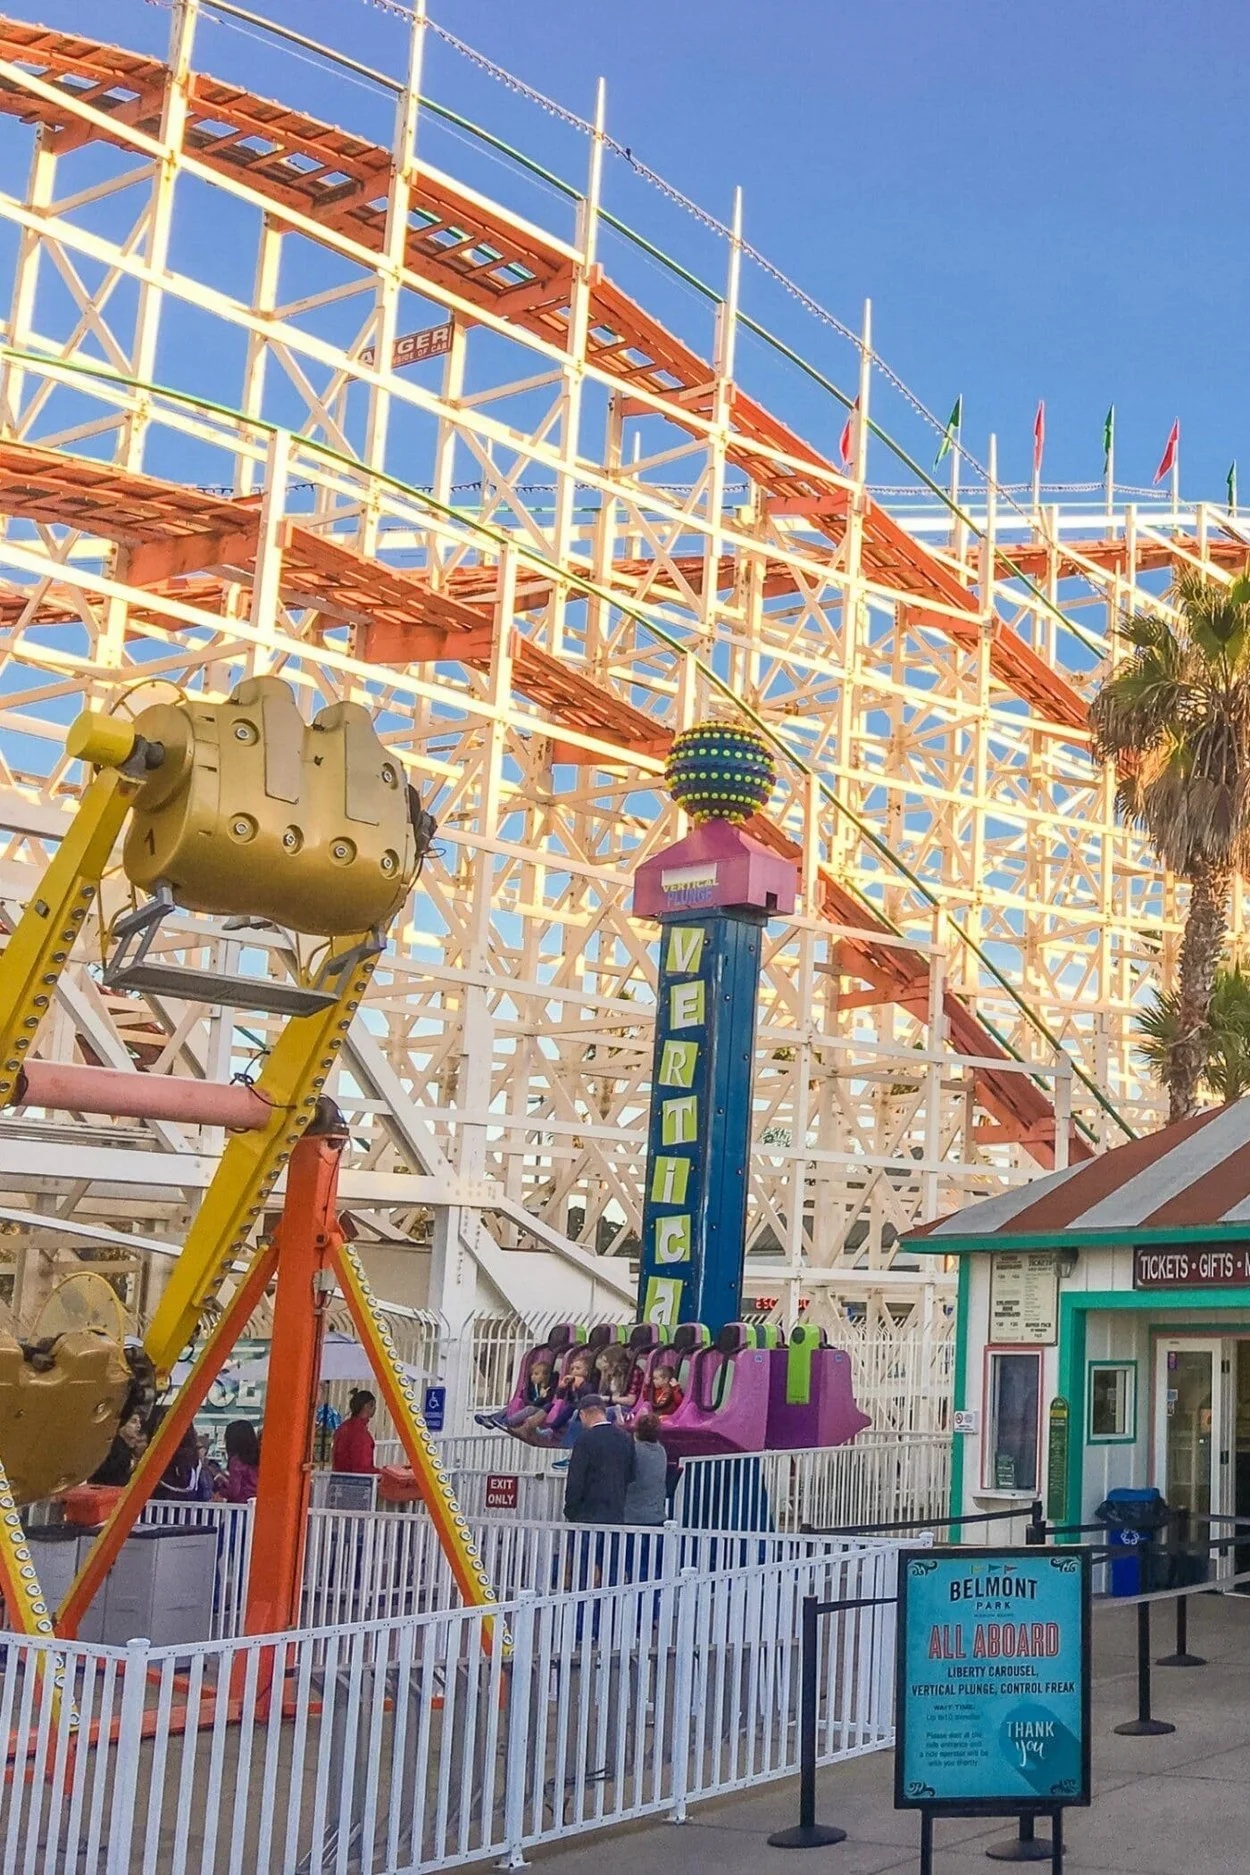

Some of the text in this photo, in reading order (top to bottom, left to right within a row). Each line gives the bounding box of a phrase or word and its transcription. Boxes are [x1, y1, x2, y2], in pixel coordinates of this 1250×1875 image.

[360, 328, 449, 364] AGER
[143, 828, 156, 857] 1
[662, 878, 720, 893] VERTICAL
[1141, 1255, 1188, 1280] TICKETS
[1199, 1253, 1233, 1278] GIFTS
[490, 1479, 514, 1490] EXIT
[487, 1494, 515, 1505] ONLY
[950, 1576, 1038, 1601] BELMONT
[976, 1601, 1011, 1610] PARK
[928, 1622, 1060, 1659] ALL ABOARD
[948, 1665, 1039, 1678] LIBERTY CAROUSEL,
[912, 1682, 1075, 1696] VERTICAL PLUNGE, CONTROL FREAK
[1006, 1720, 1055, 1739] THANK
[1015, 1741, 1044, 1767] you
